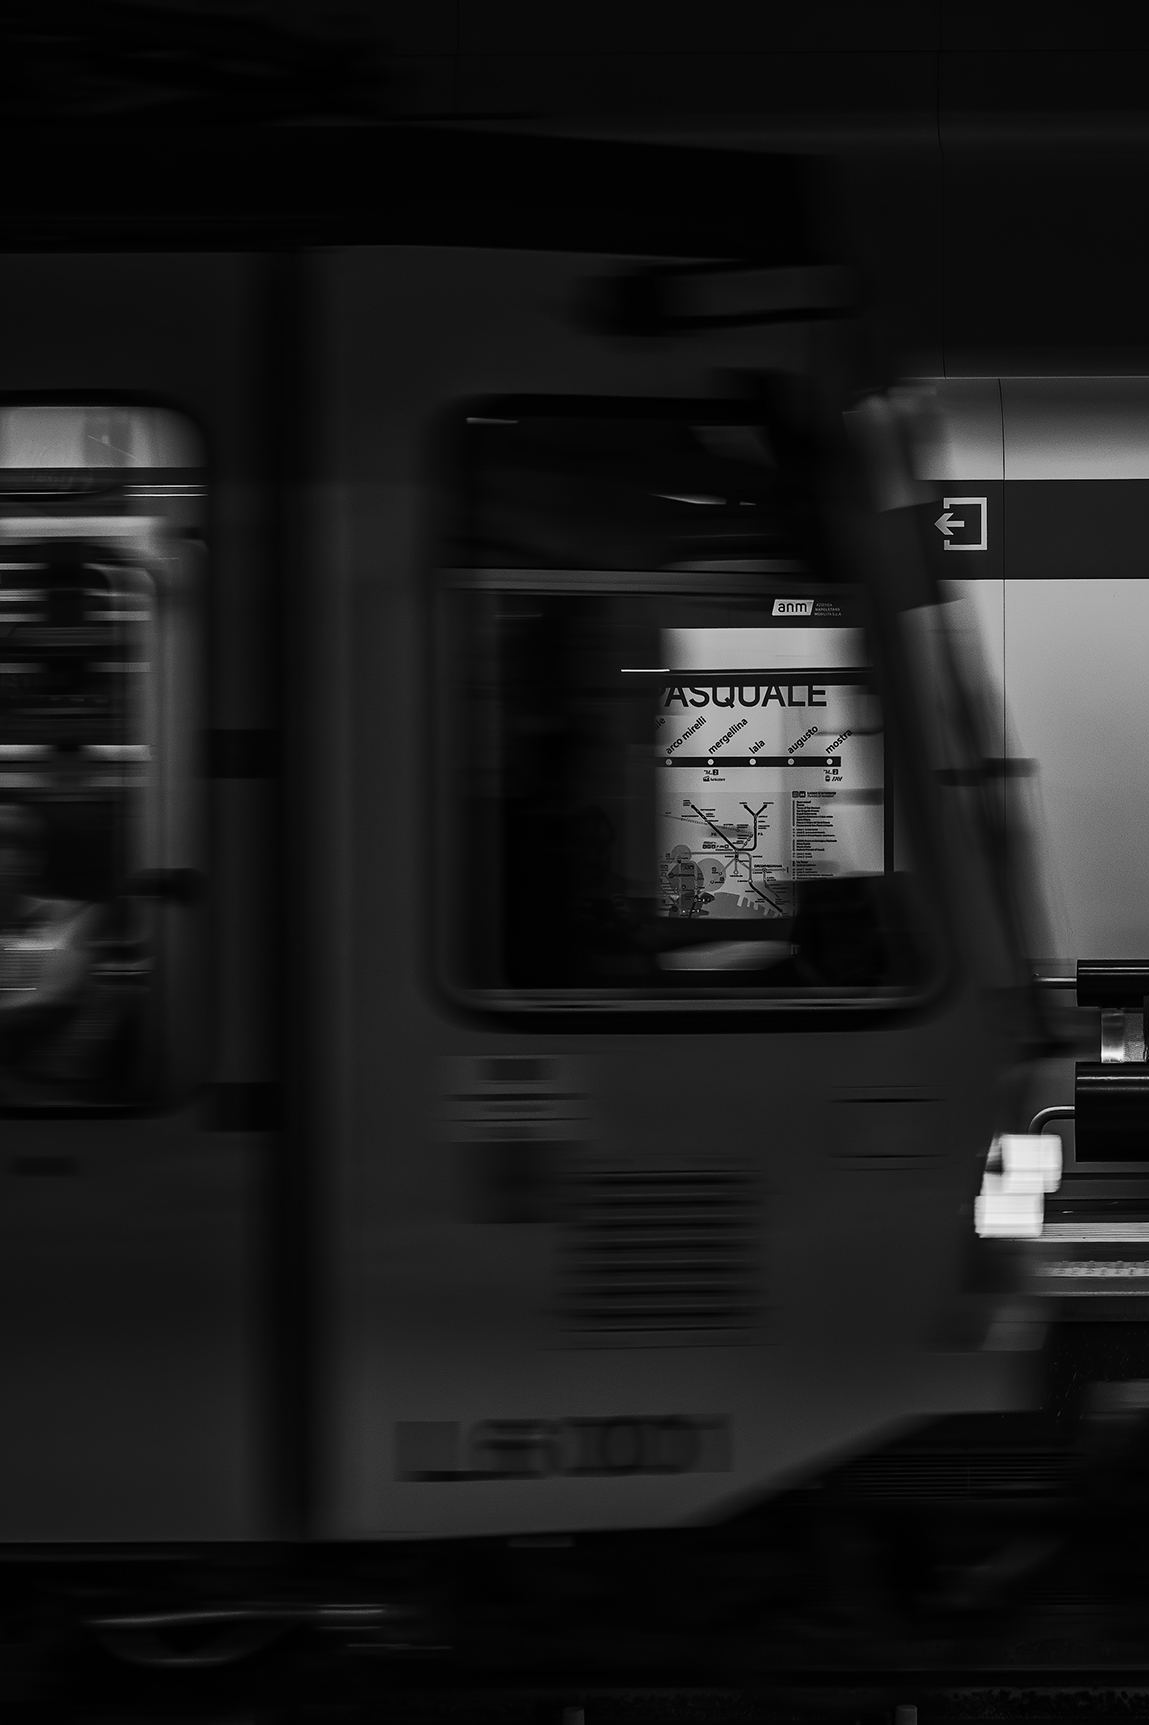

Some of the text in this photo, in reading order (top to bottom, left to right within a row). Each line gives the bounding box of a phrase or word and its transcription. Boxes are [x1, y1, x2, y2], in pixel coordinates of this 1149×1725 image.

[777, 602, 807, 613] anm
[660, 685, 828, 709] ASQUALE
[666, 737, 683, 755] arco
[681, 715, 707, 741] mirelli
[707, 717, 749, 755] mergellina
[748, 738, 766, 755] lala
[787, 724, 819, 755] augusto
[825, 727, 854, 755] mostra
